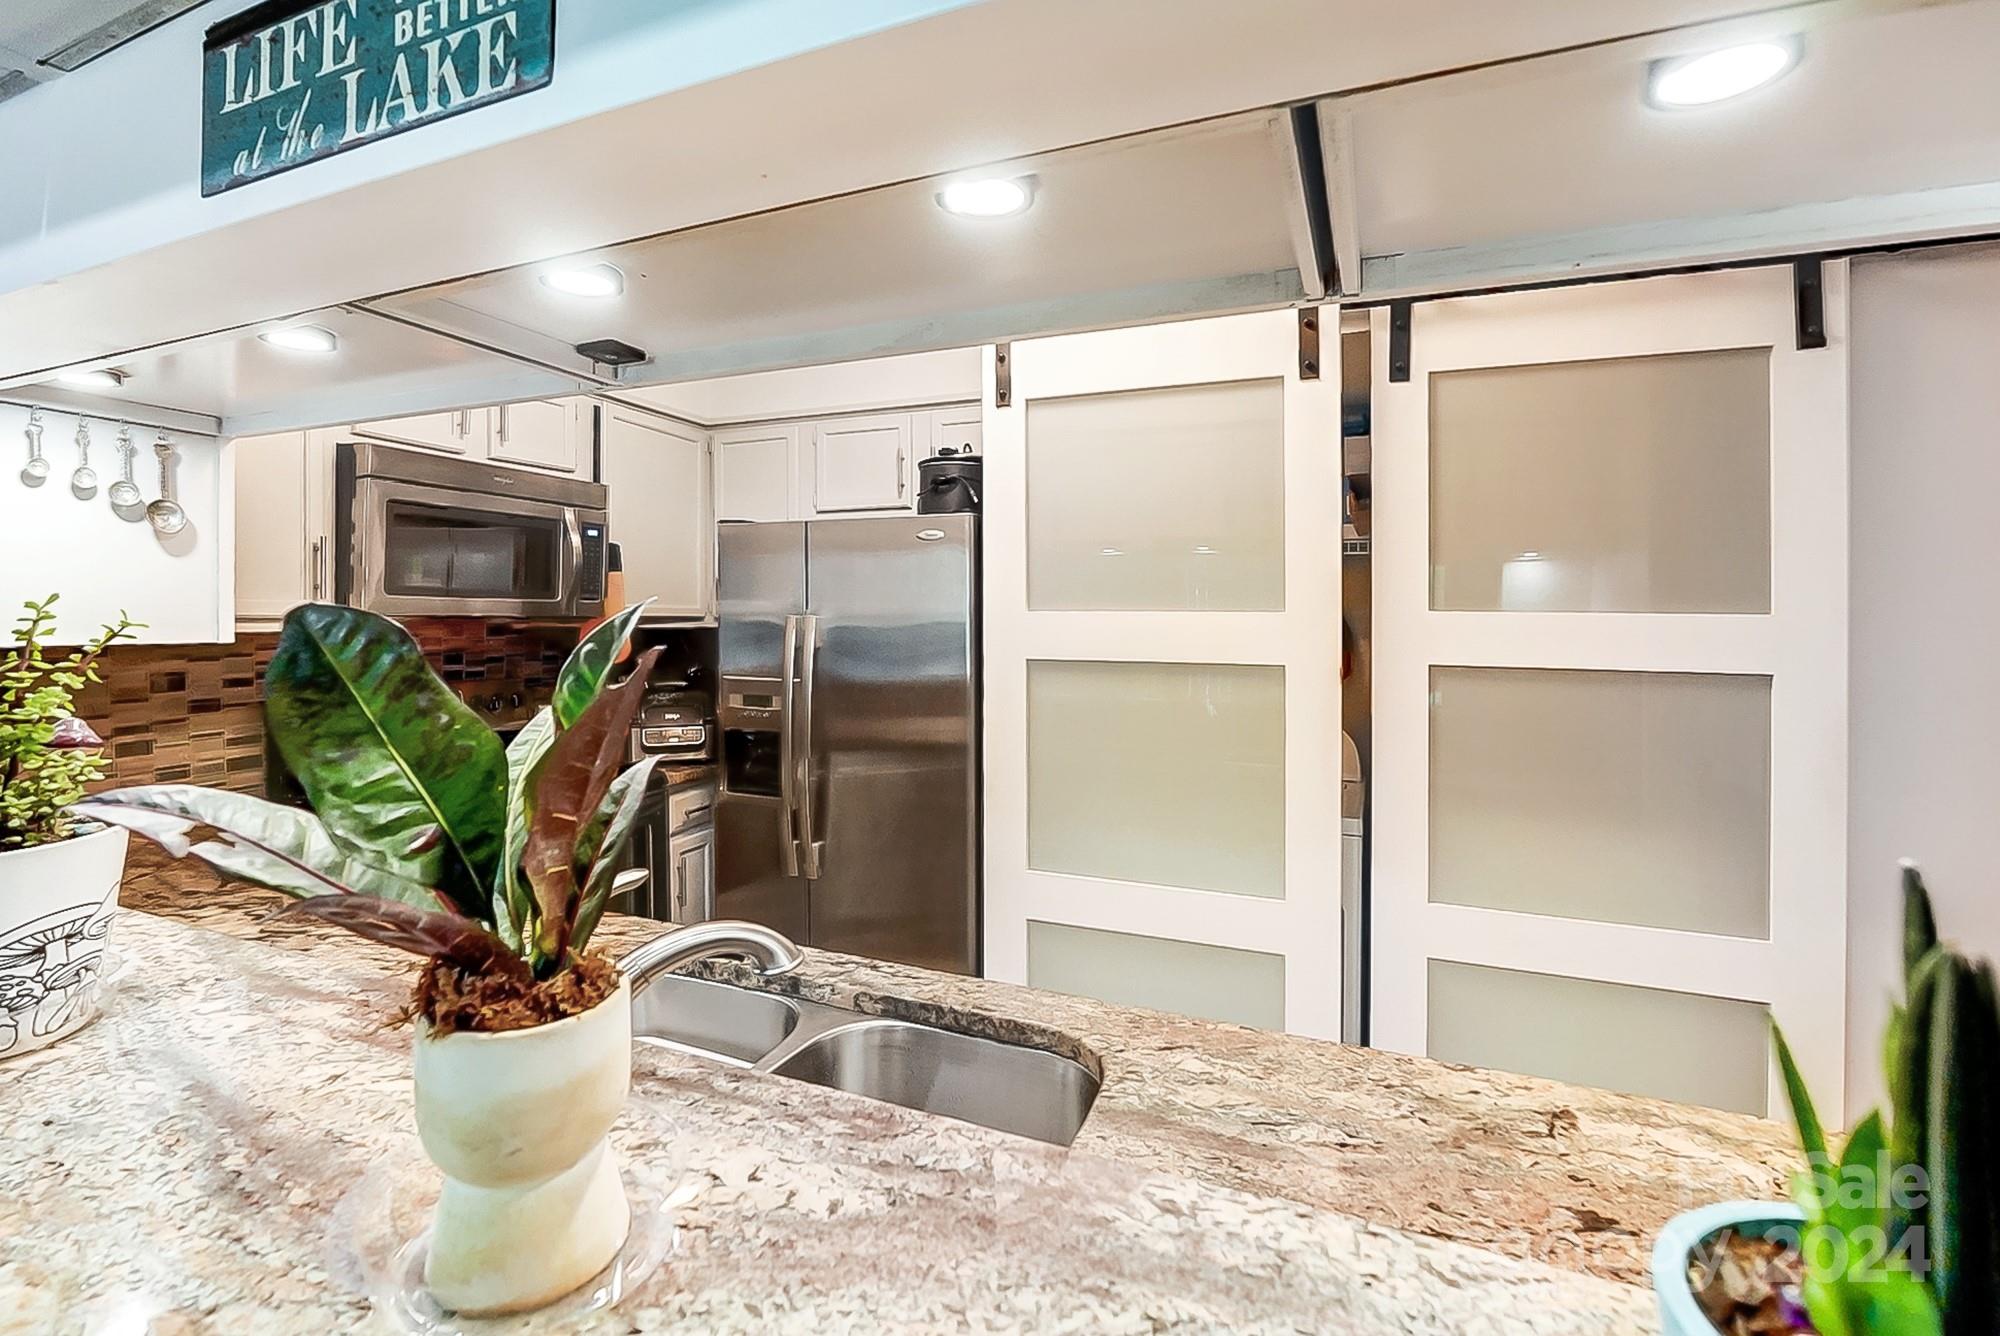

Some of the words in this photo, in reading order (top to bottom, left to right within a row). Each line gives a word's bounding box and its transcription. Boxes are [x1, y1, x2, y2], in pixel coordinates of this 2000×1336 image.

[220, 0, 358, 114] LIFE
[394, 0, 515, 46] BETT
[233, 126, 267, 176] at
[275, 88, 325, 161] the
[340, 11, 517, 145] LAKE
